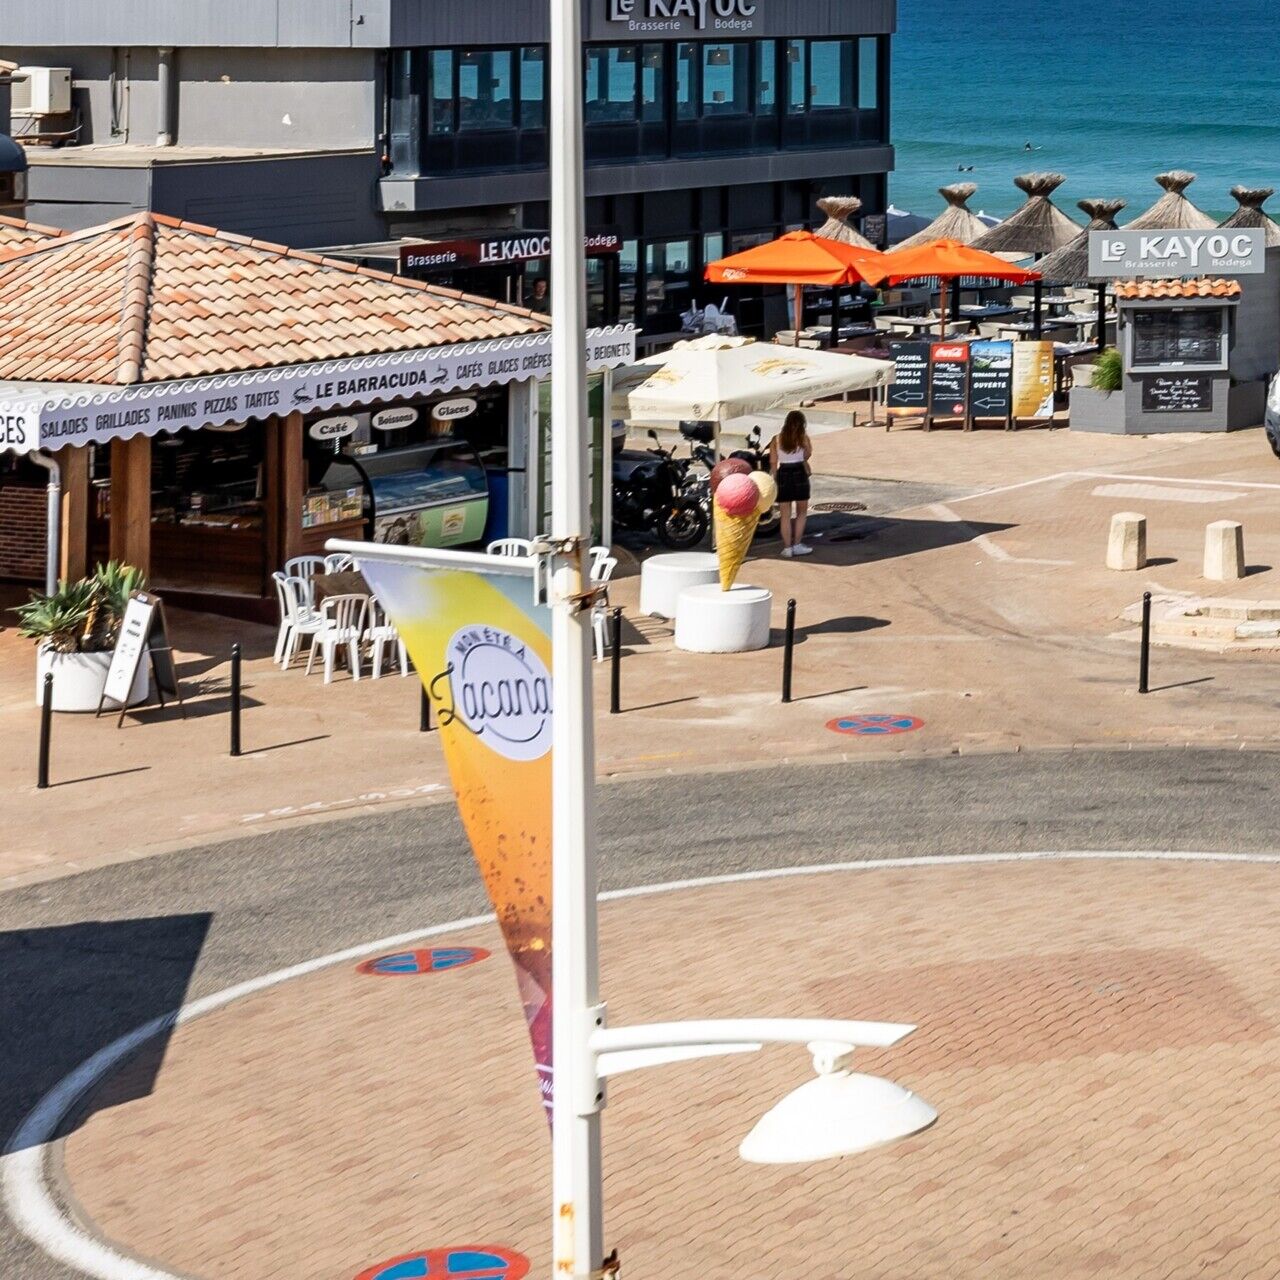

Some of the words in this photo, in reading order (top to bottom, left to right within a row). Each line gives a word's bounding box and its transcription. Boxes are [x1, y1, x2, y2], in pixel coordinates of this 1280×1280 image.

[629, 20, 680, 31] Brasserie
[715, 18, 752, 31] Bodega
[407, 250, 457, 267] Brasserie
[480, 242, 499, 262] LE
[501, 235, 550, 259] KAYOC
[584, 234, 618, 247] Bodega
[1102, 239, 1127, 262] Le
[1140, 234, 1252, 267] KAYOC
[1125, 260, 1178, 269] Brasserie
[1212, 258, 1252, 268] Bodega
[41, 416, 88, 439] SALADES
[96, 408, 151, 431] GRILLADES
[157, 402, 198, 421] PANINIS
[203, 395, 238, 415] PIZZAS
[244, 390, 280, 409] TARTES
[315, 383, 334, 399] LE
[336, 369, 428, 395] BARRACUDA
[456, 360, 483, 380] CAFÉS
[488, 357, 520, 375] GLACES
[522, 352, 552, 369] CRÊPES
[594, 342, 631, 360] BEIGNETS
[973, 381, 1007, 389] OUVERTE
[438, 404, 470, 416] Glaces
[378, 412, 413, 426] Boissons
[319, 421, 348, 435] Café
[455, 630, 481, 655] MON
[430, 660, 553, 735] Lacana
